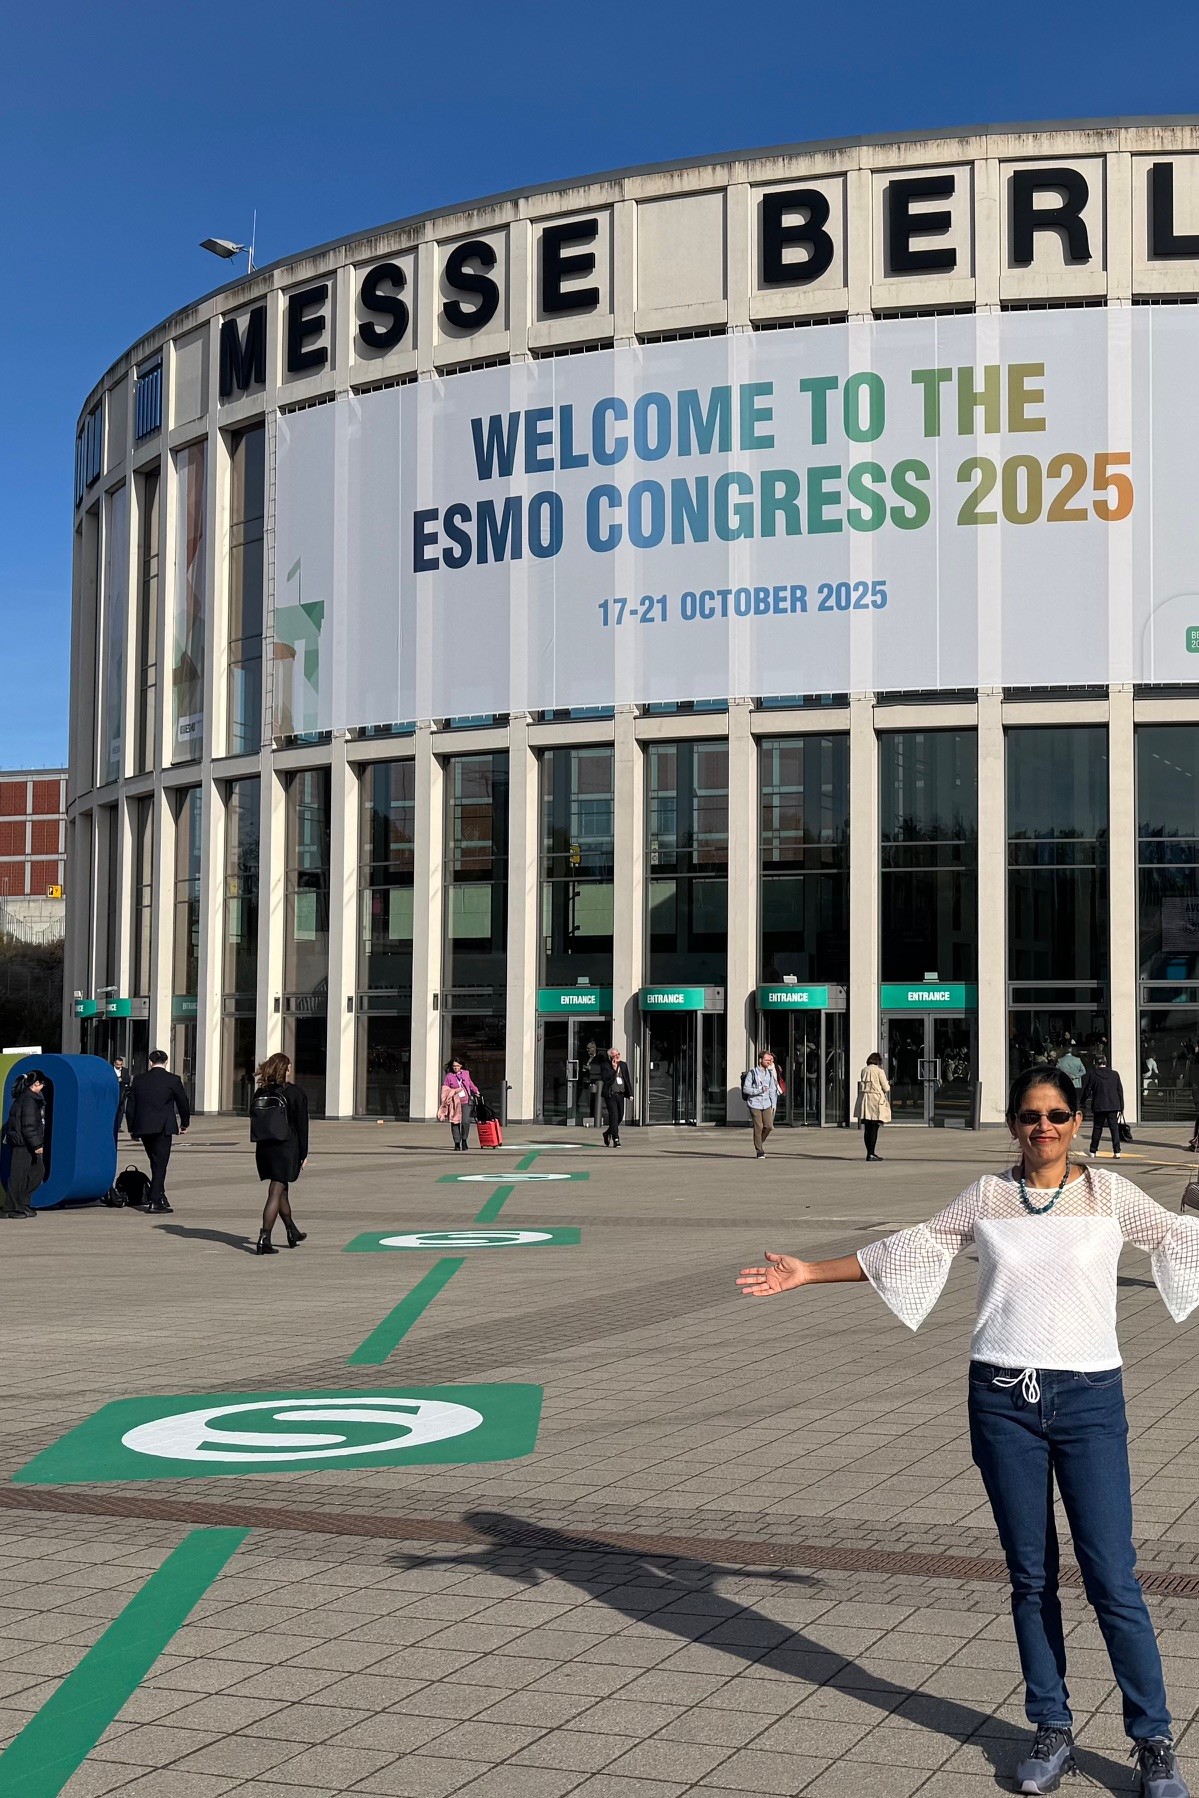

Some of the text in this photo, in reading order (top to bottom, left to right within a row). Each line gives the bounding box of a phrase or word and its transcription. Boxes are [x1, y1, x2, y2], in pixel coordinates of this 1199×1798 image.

[219, 218, 600, 397] MESSE
[470, 362, 1047, 481] WELCOME TO THE
[413, 451, 1134, 574] ESMO CONGRESS 2025
[598, 580, 888, 627] 17-21 OCTOBER 2025
[561, 995, 596, 1005] ENTRANCE
[647, 993, 685, 1004] ENTRANCE
[768, 991, 809, 1002] ENTRANCE
[907, 991, 950, 1002] ENTRANCE
